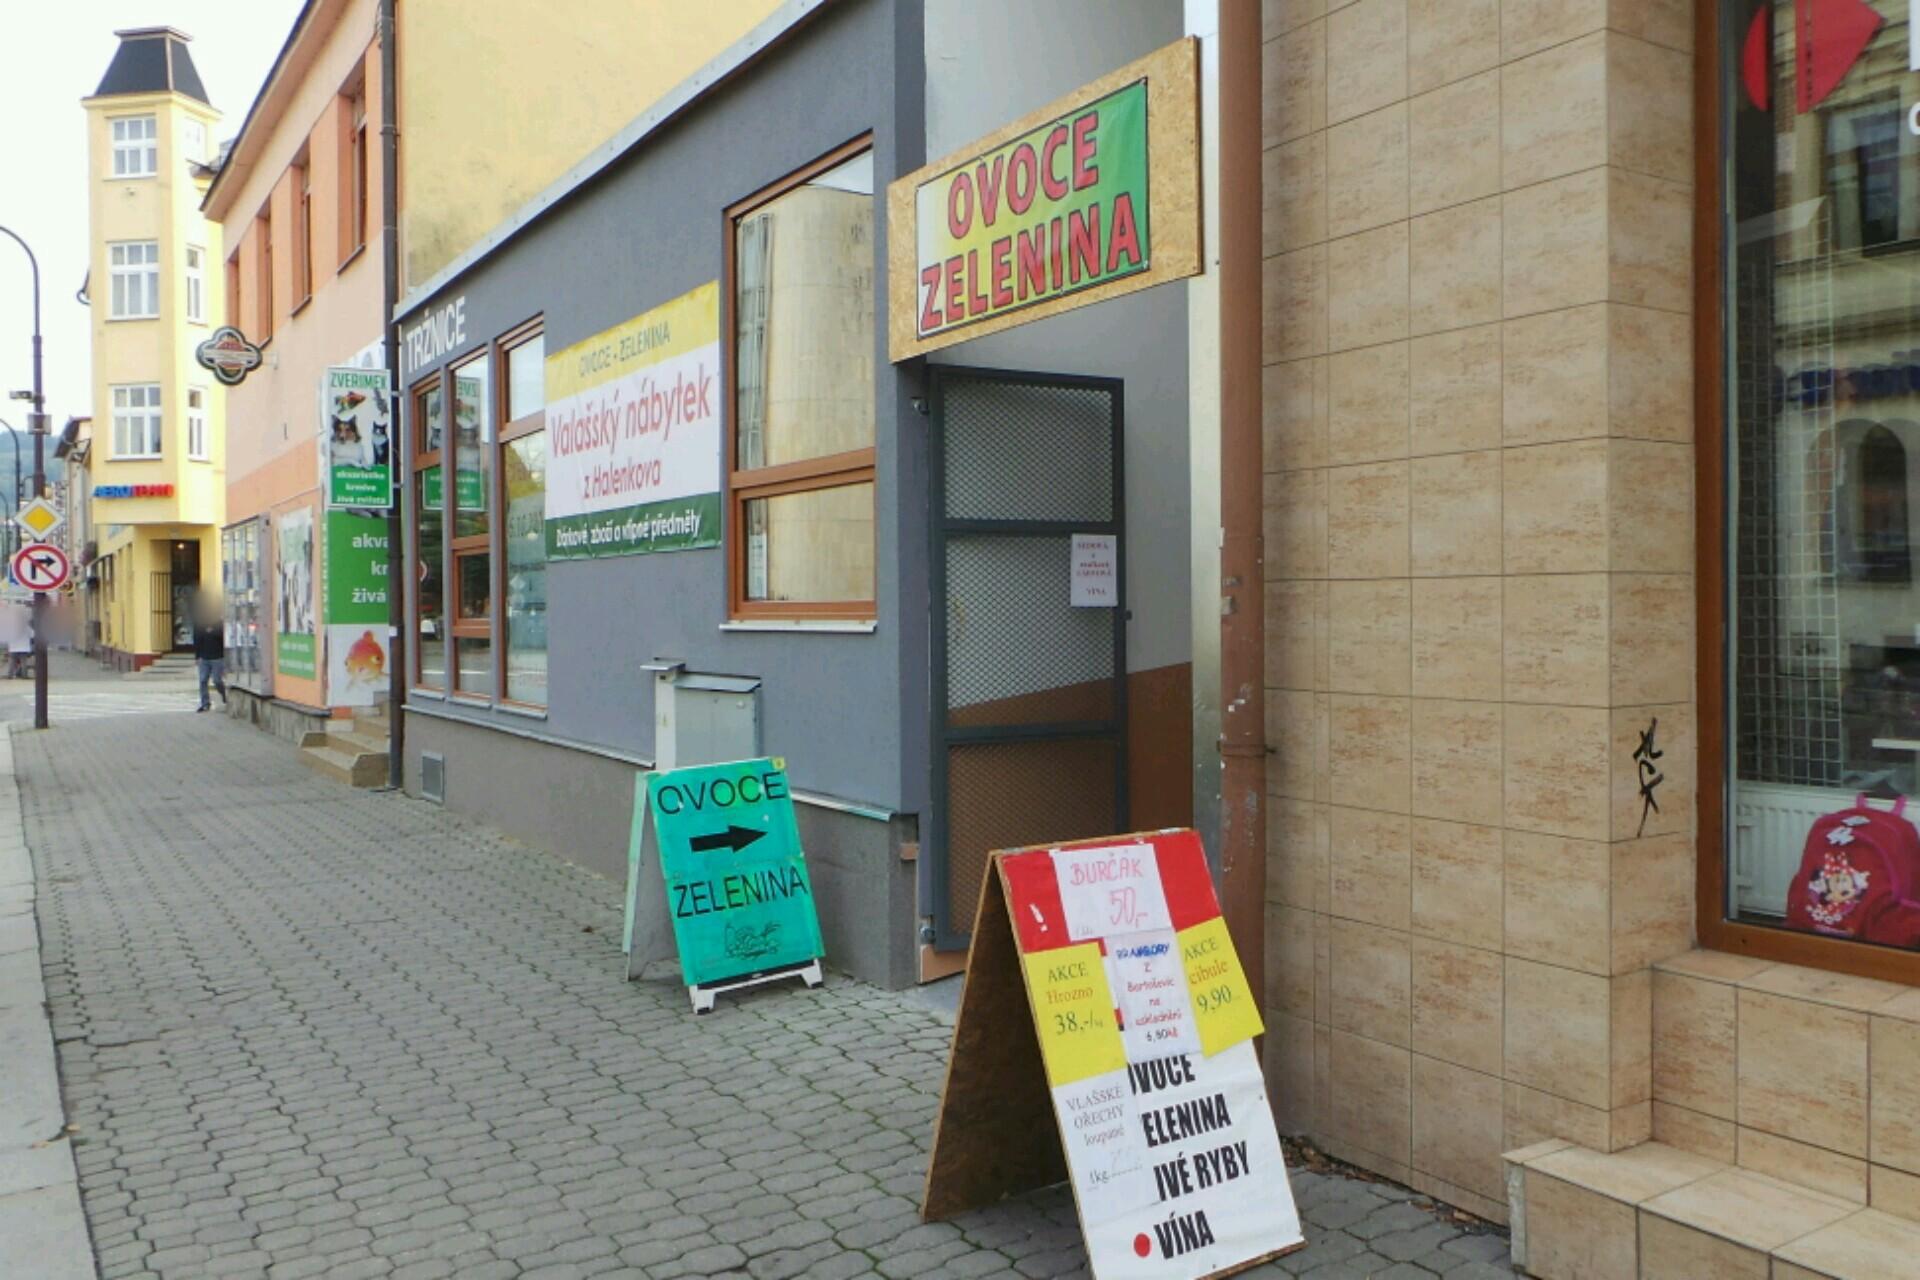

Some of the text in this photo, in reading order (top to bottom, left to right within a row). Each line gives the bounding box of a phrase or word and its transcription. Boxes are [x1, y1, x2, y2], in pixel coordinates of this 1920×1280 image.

[948, 110, 1099, 240] OVOCE
[921, 192, 1142, 331] ZELENINA
[406, 295, 466, 373] TRŽNICE
[579, 345, 611, 378] OVOCE
[619, 320, 670, 362] ZELENINA
[551, 362, 711, 457] Valašský nábytek
[584, 456, 662, 498] z Halenkova
[651, 509, 701, 541] předměty
[351, 587, 386, 604] živá
[657, 771, 786, 815] OVOCE
[1070, 848, 1144, 886] BURČÁK
[673, 865, 808, 918] ZELENINA
[1048, 961, 1088, 984] AKCE
[1184, 937, 1218, 962] AKCE
[1190, 959, 1229, 985] cibule
[1127, 1054, 1196, 1096] VOCE
[1140, 1092, 1232, 1148] ELENINA
[1153, 1151, 1194, 1201] IVÉ
[1193, 1140, 1250, 1189] RYBY
[1154, 1210, 1215, 1260] VÍNA
